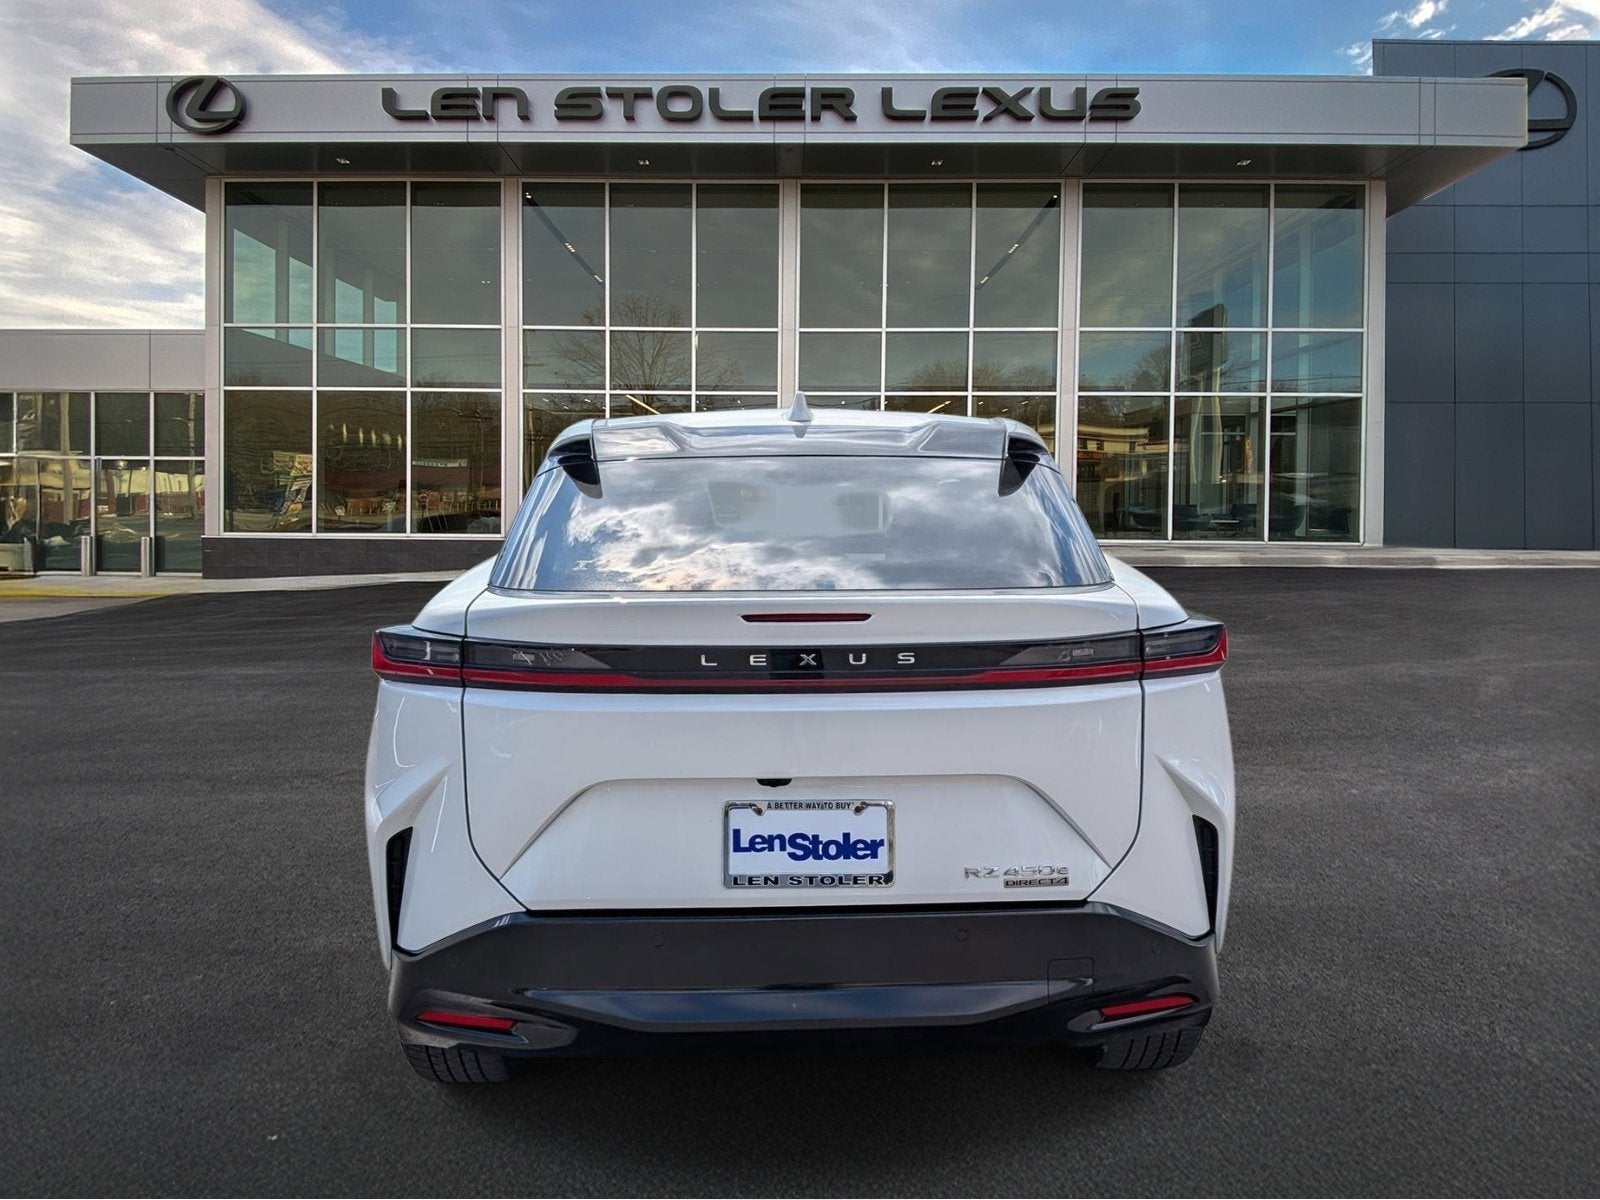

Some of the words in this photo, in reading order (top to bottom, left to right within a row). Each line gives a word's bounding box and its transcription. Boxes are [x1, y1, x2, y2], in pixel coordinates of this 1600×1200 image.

[381, 87, 530, 120] LEN
[554, 85, 858, 122] STOLER
[881, 87, 1142, 121] LEXUS
[700, 652, 916, 667] LEXUS
[766, 801, 772, 809] A
[774, 801, 804, 809] BETTER
[805, 801, 822, 809] WAY
[824, 801, 834, 809] TO
[835, 801, 851, 809] BUY
[964, 866, 1000, 879] RZ
[1003, 864, 1069, 877] 450e
[733, 876, 780, 886] LEN
[788, 875, 885, 886] STOLER
[1005, 877, 1069, 887] DIRECT4
